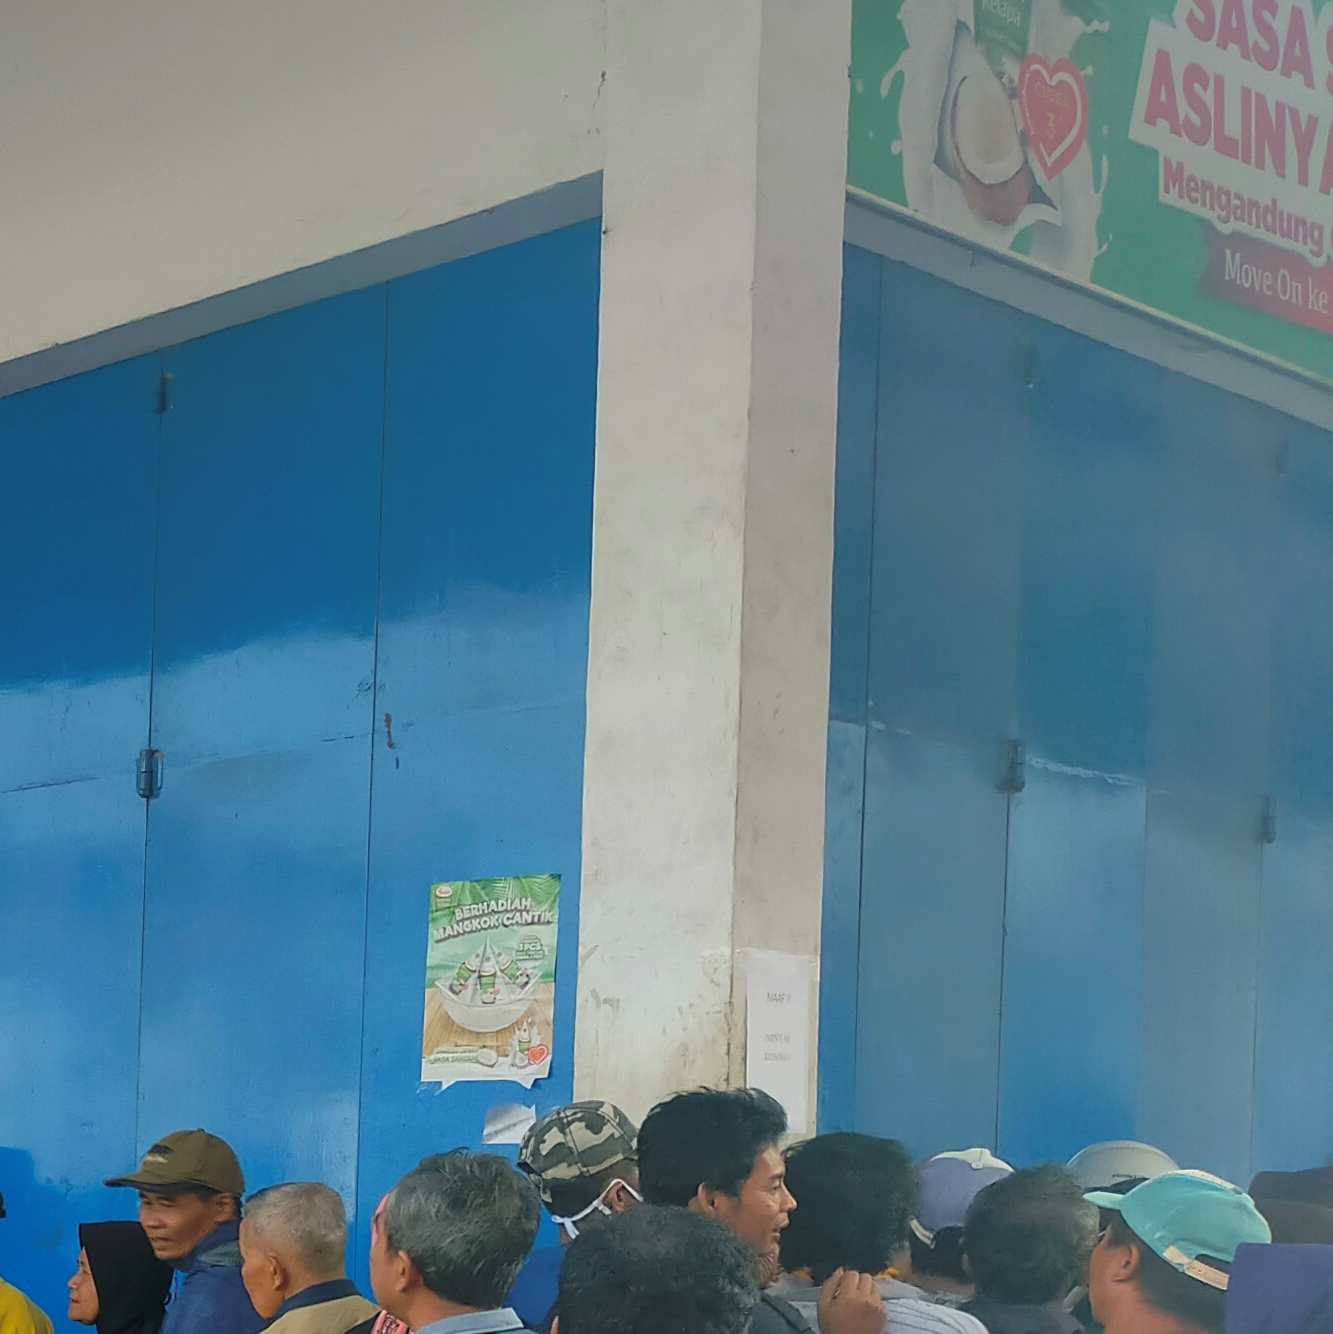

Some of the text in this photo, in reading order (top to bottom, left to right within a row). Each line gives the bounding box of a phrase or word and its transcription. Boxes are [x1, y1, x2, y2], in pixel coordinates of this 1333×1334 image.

[1163, 155, 1325, 258] Mengandung
[1224, 249, 1329, 314] Move On ke
[434, 911, 555, 942] MANGKOK CANTIK
[455, 897, 532, 922] BERHADIAH
